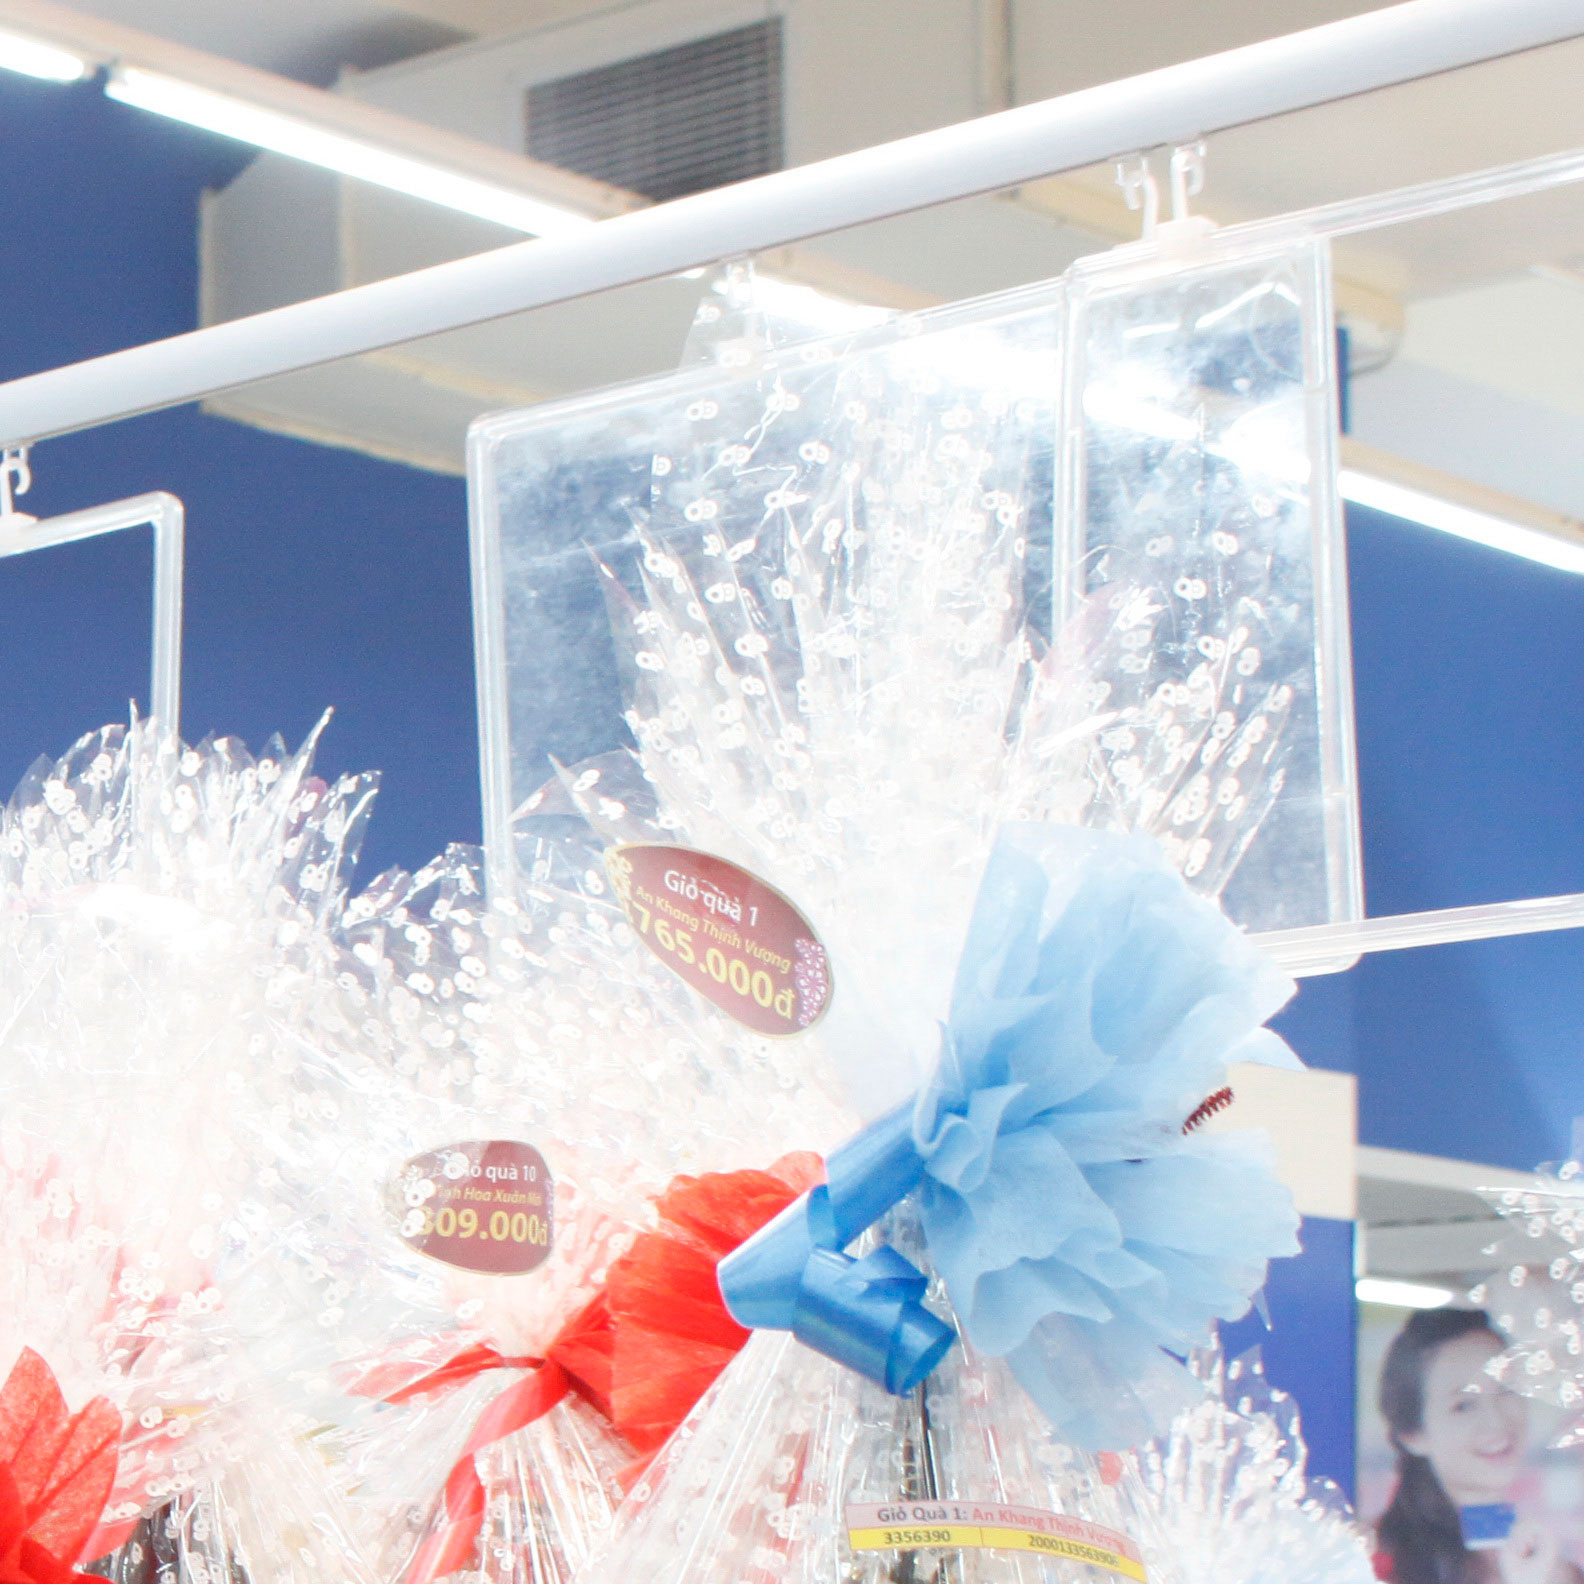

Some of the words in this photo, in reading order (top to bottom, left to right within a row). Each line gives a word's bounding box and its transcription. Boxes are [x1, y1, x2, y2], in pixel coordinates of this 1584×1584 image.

[663, 869, 698, 900] Giỏ
[748, 906, 760, 927] 1
[636, 886, 654, 904] An
[656, 896, 700, 931] Khang
[702, 918, 743, 949] Thịnh
[744, 939, 792, 974] Vượng
[629, 899, 797, 1021] 765.000đ
[485, 1163, 519, 1183] quà
[522, 1165, 537, 1183] 10
[877, 1504, 907, 1523] Giỏ
[912, 1507, 948, 1523] Quà
[972, 1508, 995, 1522] An
[998, 1510, 1046, 1532] Khang
[883, 1530, 952, 1546] 3356390
